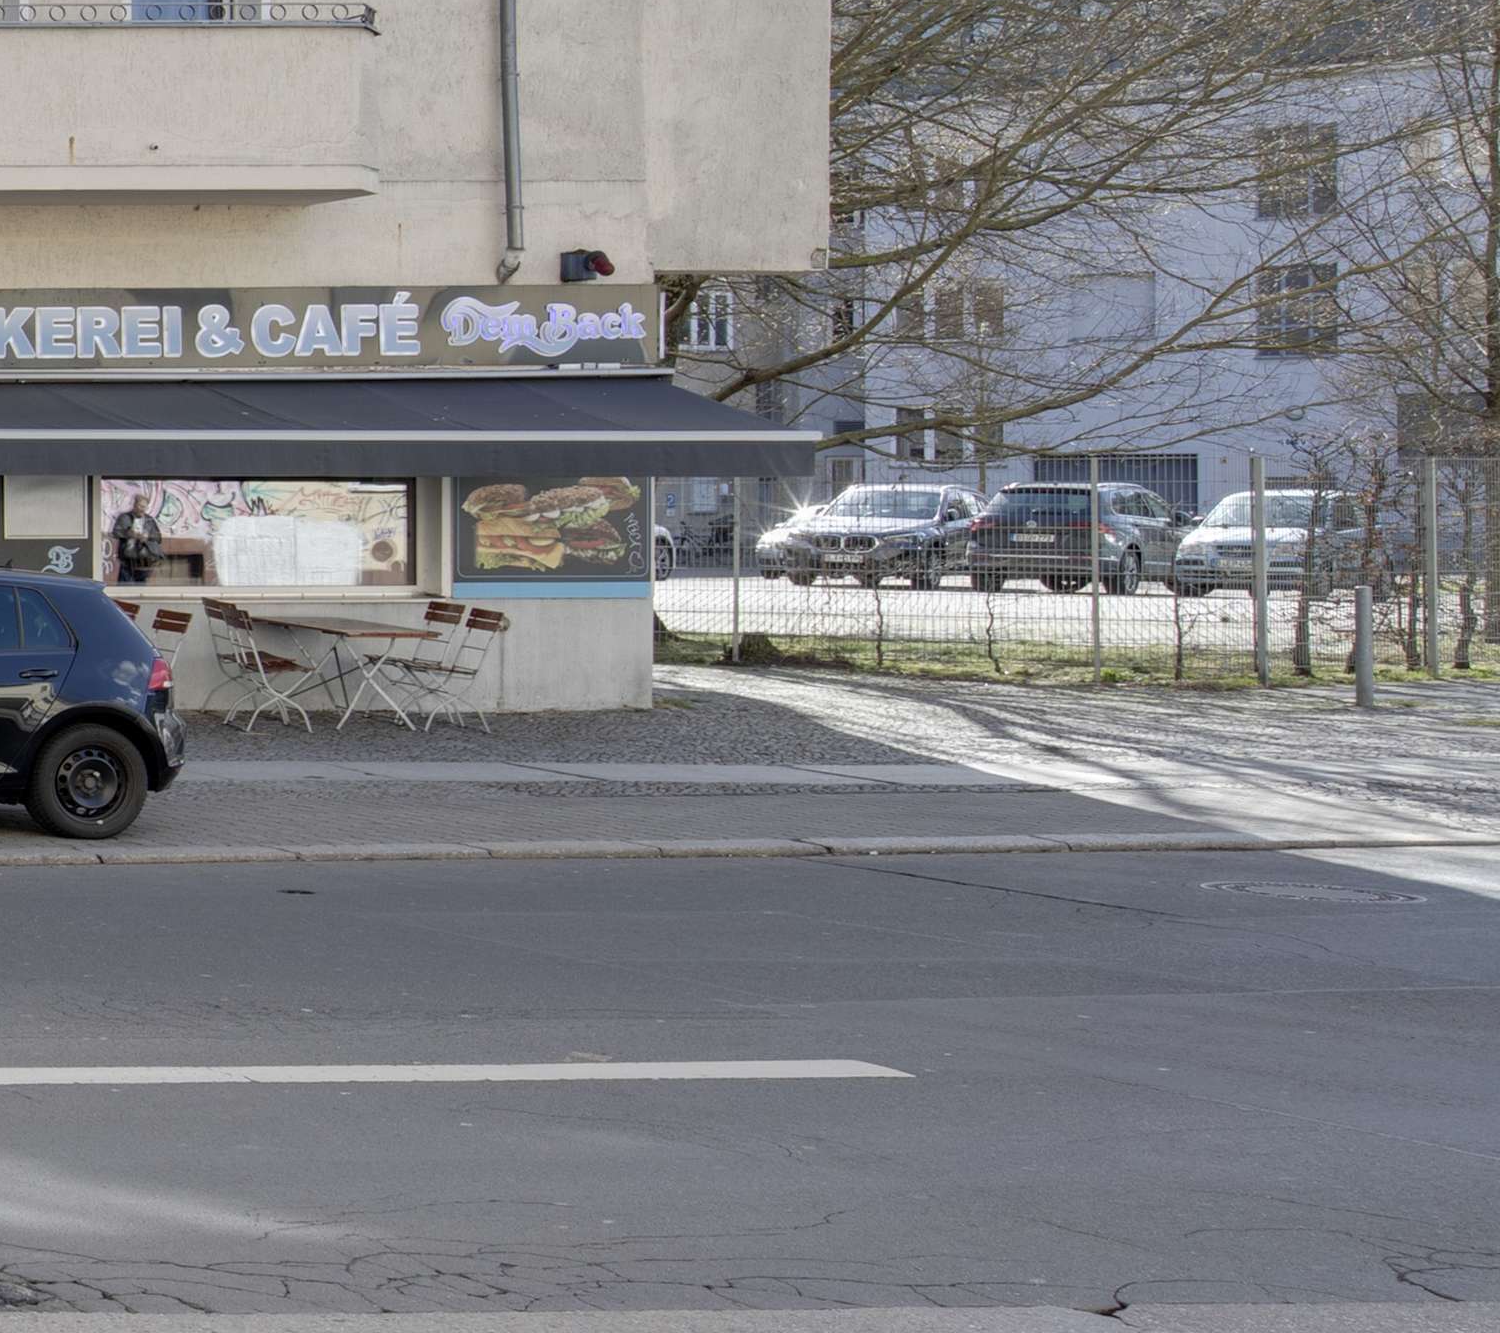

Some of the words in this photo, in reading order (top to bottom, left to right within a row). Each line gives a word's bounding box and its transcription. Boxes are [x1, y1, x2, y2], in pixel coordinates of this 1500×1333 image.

[194, 303, 246, 358] &
[250, 290, 422, 358] CAFÉ
[540, 301, 647, 356] Back
